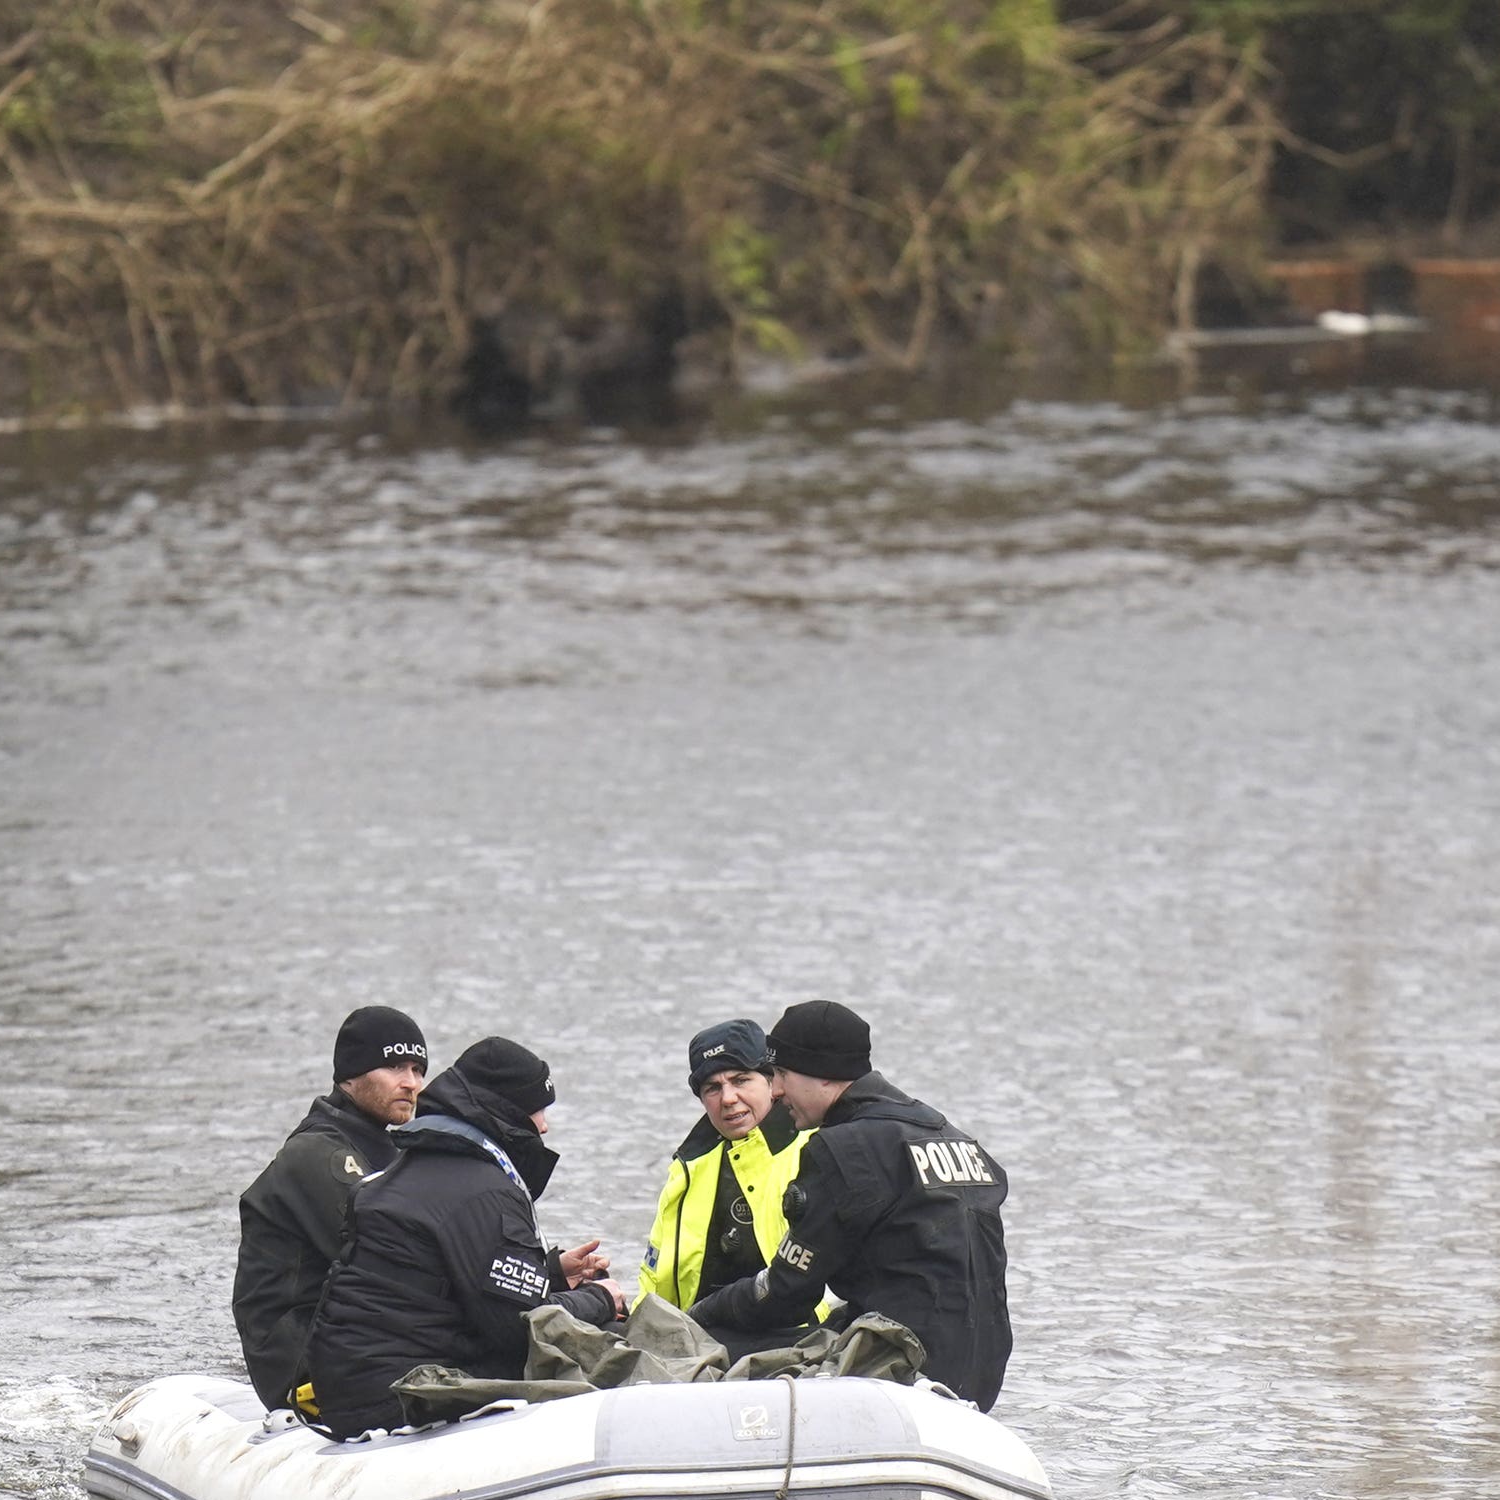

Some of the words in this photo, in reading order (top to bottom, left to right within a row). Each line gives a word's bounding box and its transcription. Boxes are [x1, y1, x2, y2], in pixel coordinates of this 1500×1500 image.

[702, 1044, 726, 1060] POLICE
[343, 1155, 365, 1177] 4
[908, 1141, 993, 1185] POLICE
[778, 1238, 815, 1272] LICE
[491, 1259, 545, 1287] POLICE
